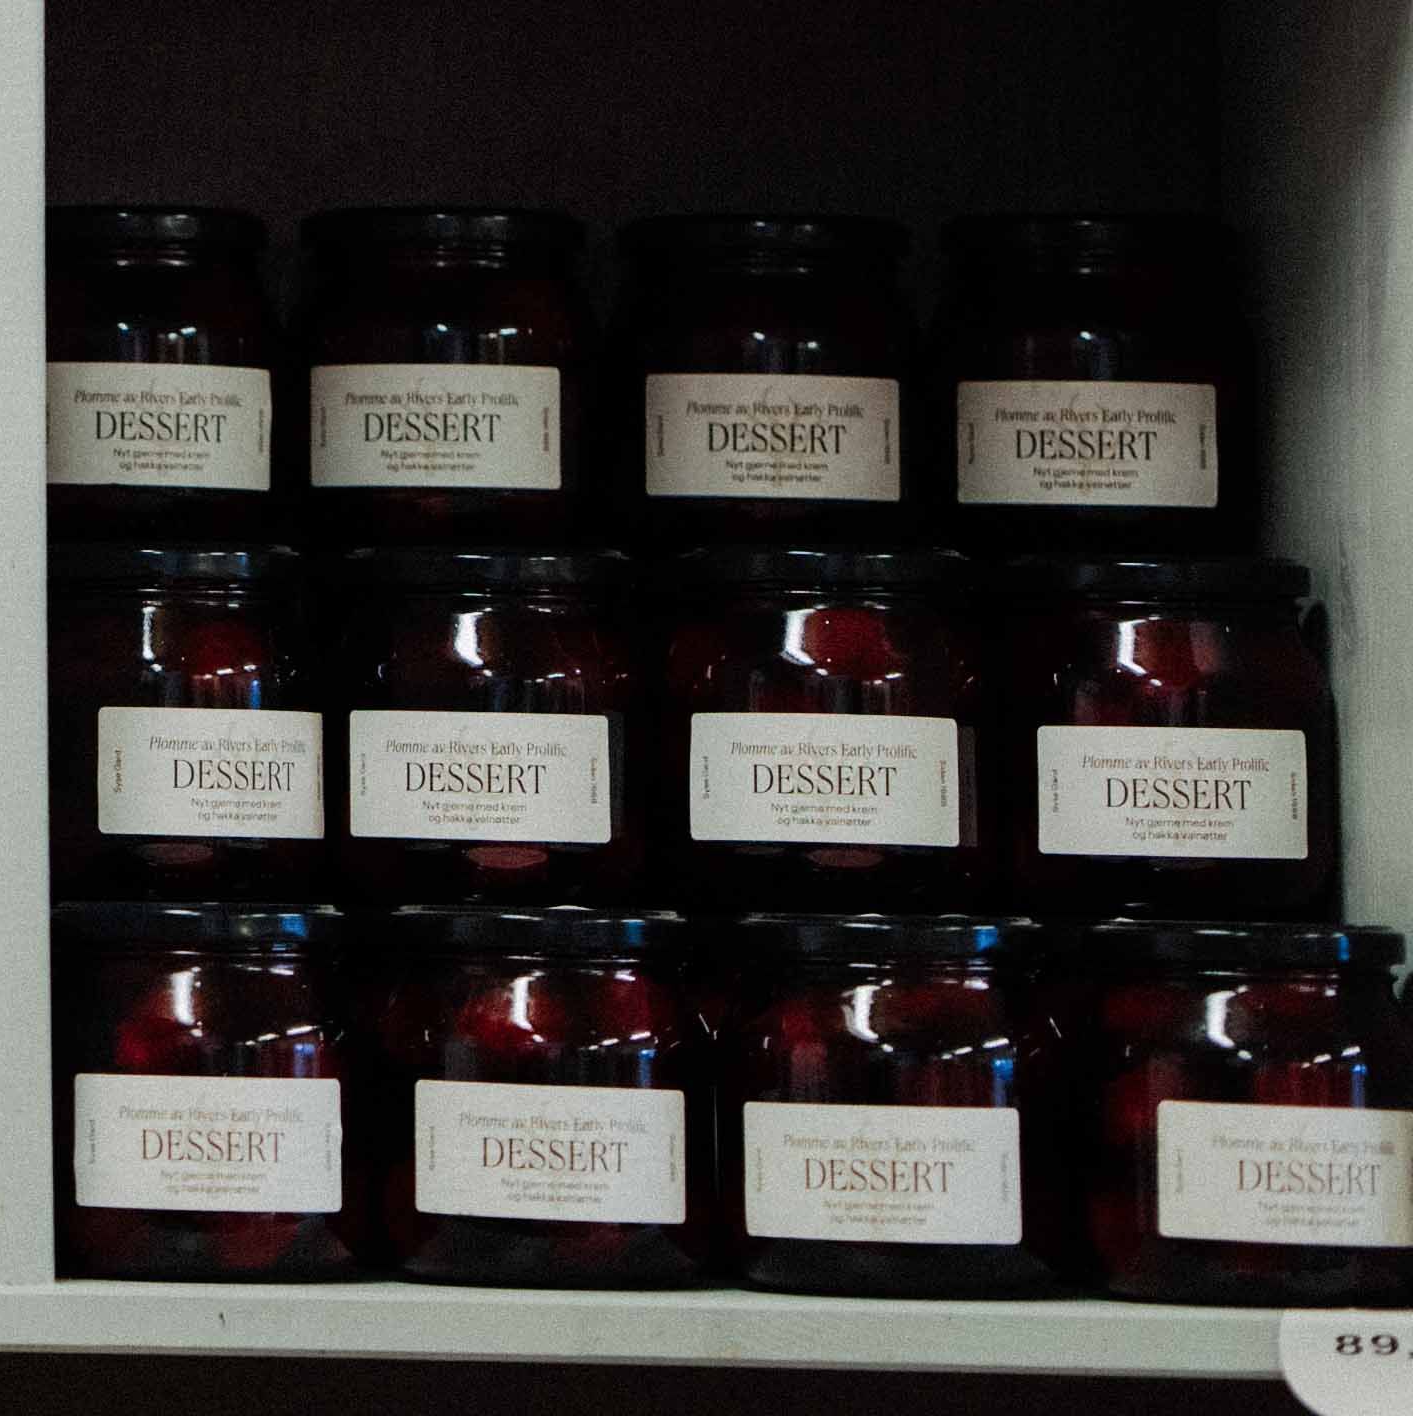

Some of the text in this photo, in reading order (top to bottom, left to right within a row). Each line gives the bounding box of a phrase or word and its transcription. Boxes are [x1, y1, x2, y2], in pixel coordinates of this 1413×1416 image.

[96, 411, 227, 443] DESSERT
[364, 412, 501, 443] DESSERT
[708, 422, 847, 454] DESSERT
[1015, 429, 1157, 460] DESSERT
[148, 736, 199, 752] Plomme
[201, 739, 215, 751] av
[218, 737, 253, 753] Rivers
[385, 740, 430, 754] Plomme
[432, 743, 446, 754] av
[449, 740, 487, 755] Rivers
[491, 742, 523, 757] Early
[730, 742, 777, 756] Plomme
[780, 744, 794, 756] av
[798, 742, 837, 756] Rivers
[841, 743, 873, 759] Early
[172, 759, 295, 792] DESSERT
[406, 762, 547, 794] DESSERT
[752, 763, 898, 796] DESSERT
[1082, 755, 1130, 770] Plomme
[1135, 759, 1150, 770] av
[1154, 756, 1194, 771] Rivers
[1197, 757, 1228, 773] Early
[1106, 777, 1252, 810] DESSERT
[142, 1129, 285, 1163] DESSERT
[482, 1136, 629, 1173] DESSERT
[804, 1158, 954, 1193] DESSERT
[1235, 1159, 1381, 1197] DESSERT
